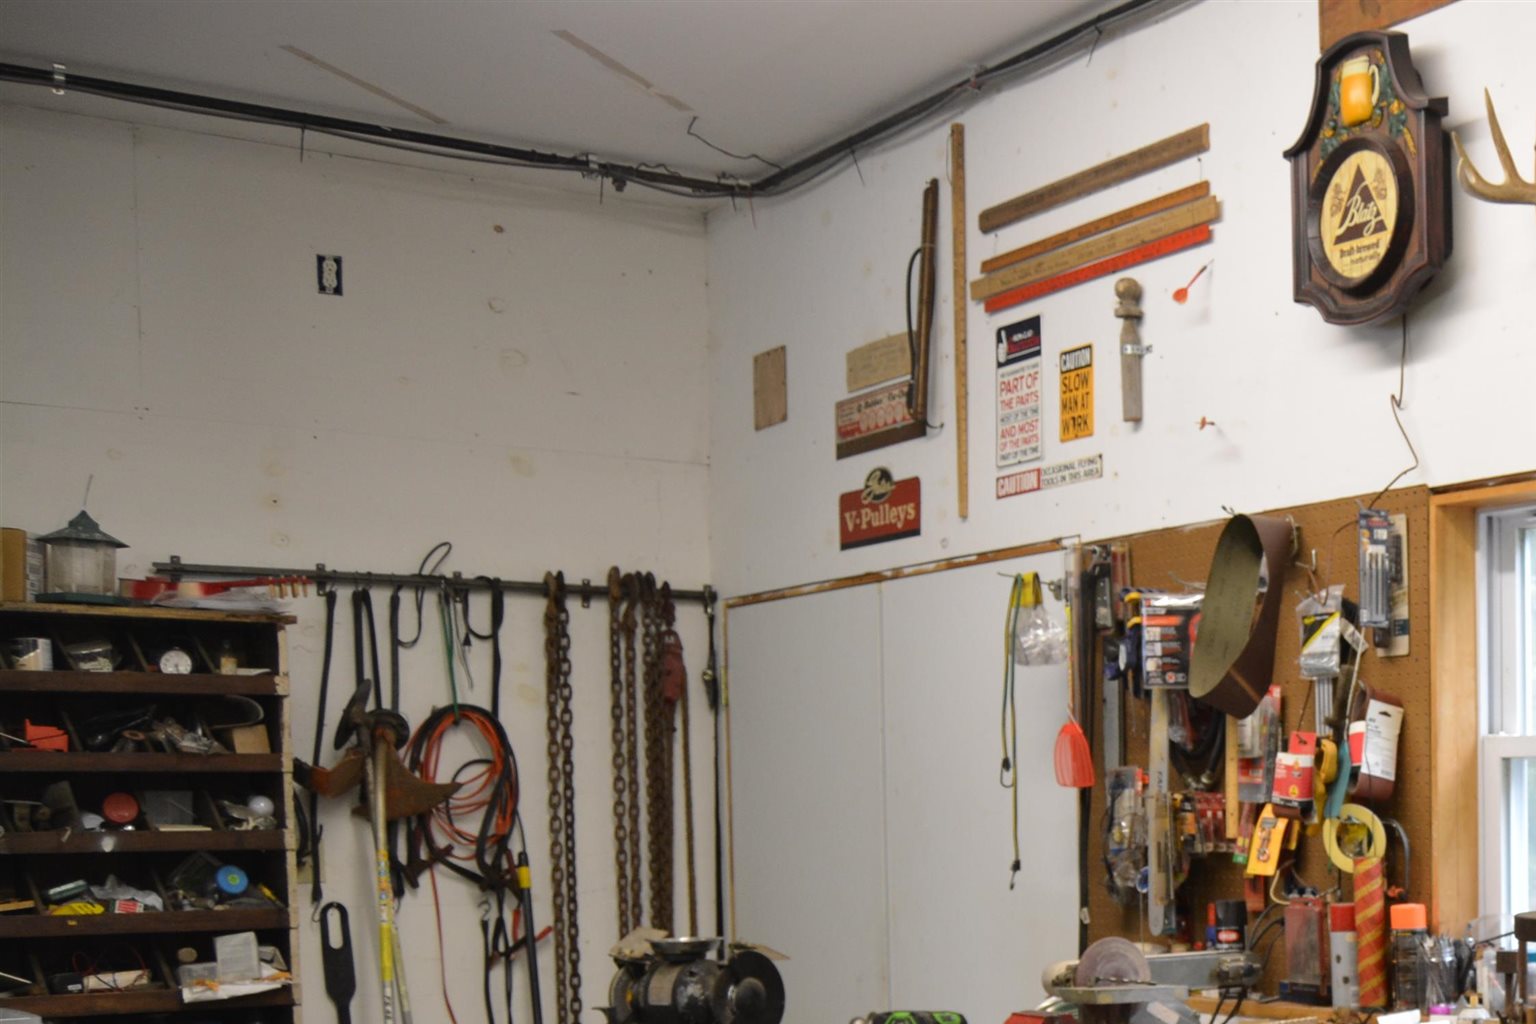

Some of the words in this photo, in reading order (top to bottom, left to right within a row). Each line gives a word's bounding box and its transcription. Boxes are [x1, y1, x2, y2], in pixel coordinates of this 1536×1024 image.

[1335, 181, 1384, 237] Blatz
[1061, 347, 1092, 373] CAUTION
[1000, 376, 1024, 396] PART
[1025, 371, 1039, 389] OF
[1062, 372, 1090, 394] SLOW
[1000, 398, 1014, 411] THE
[1016, 391, 1040, 407] PARTS
[1062, 395, 1079, 412] MAN
[1080, 391, 1090, 410] AT
[1000, 424, 1016, 439] AND
[1018, 418, 1039, 434] MOST
[1022, 434, 1039, 446] PARTS
[998, 471, 1038, 497] CAUTION
[844, 502, 917, 532] V-Pulleys
